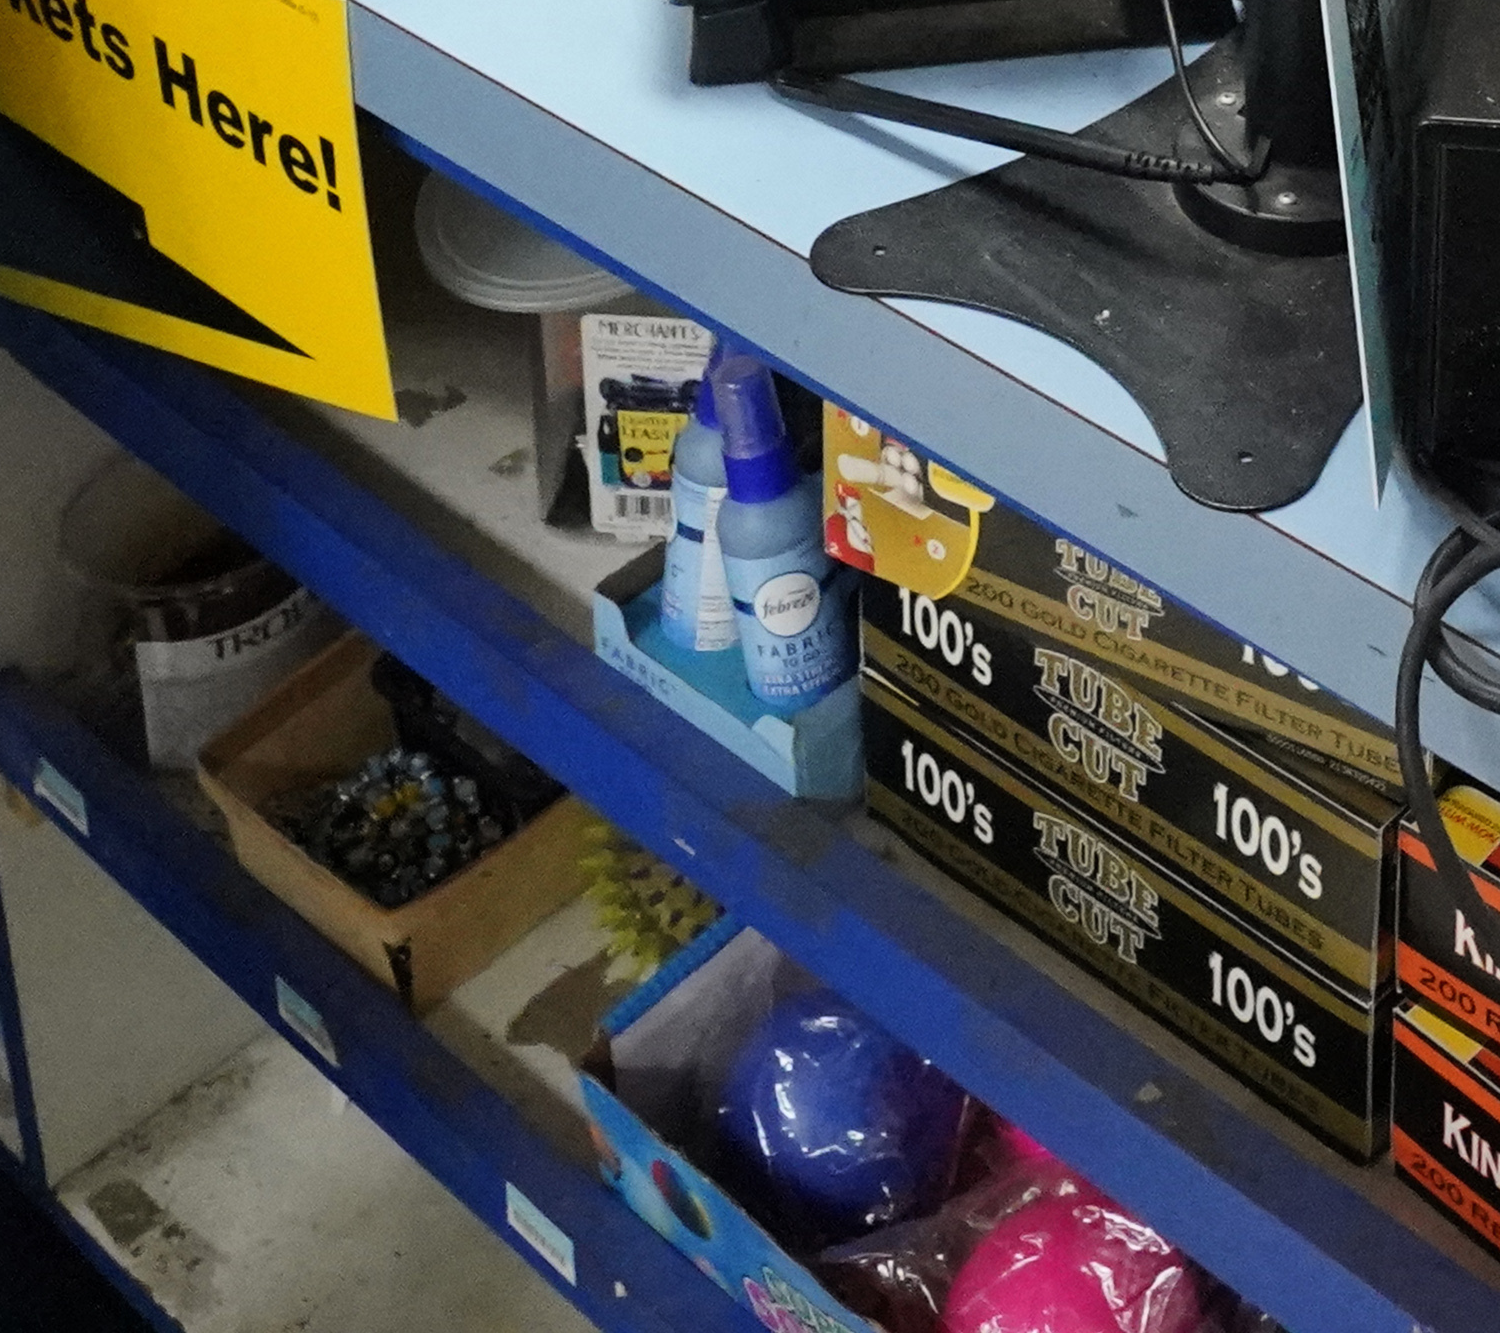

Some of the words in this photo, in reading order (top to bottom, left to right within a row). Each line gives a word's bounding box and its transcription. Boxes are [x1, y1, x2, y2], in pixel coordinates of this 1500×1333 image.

[153, 34, 343, 213] Here!
[757, 626, 832, 658] FABRIC
[761, 590, 816, 618] febreze
[898, 587, 992, 687] 100's
[1066, 585, 1149, 641] CUT
[601, 637, 670, 695] FABRIC
[966, 574, 1014, 610] 200
[1021, 598, 1092, 640] GOLD
[1092, 628, 1231, 703] CIGARETTE
[1235, 686, 1323, 741] FILTER
[1034, 648, 1164, 762] TUBE
[897, 654, 941, 697] 200
[947, 684, 1010, 742] GOLD
[1014, 732, 1143, 829] CIGARETTE
[1152, 819, 1234, 892] FILTER
[1240, 880, 1326, 953] TUBES
[901, 739, 994, 845] 100's
[1048, 712, 1148, 803] CUT
[1033, 812, 1161, 928] TUBE
[1213, 782, 1323, 900] 100's
[1048, 875, 1144, 965] CUT
[1209, 952, 1317, 1069] 100's
[1420, 968, 1477, 1017] 200
[1411, 1153, 1465, 1205] 200
